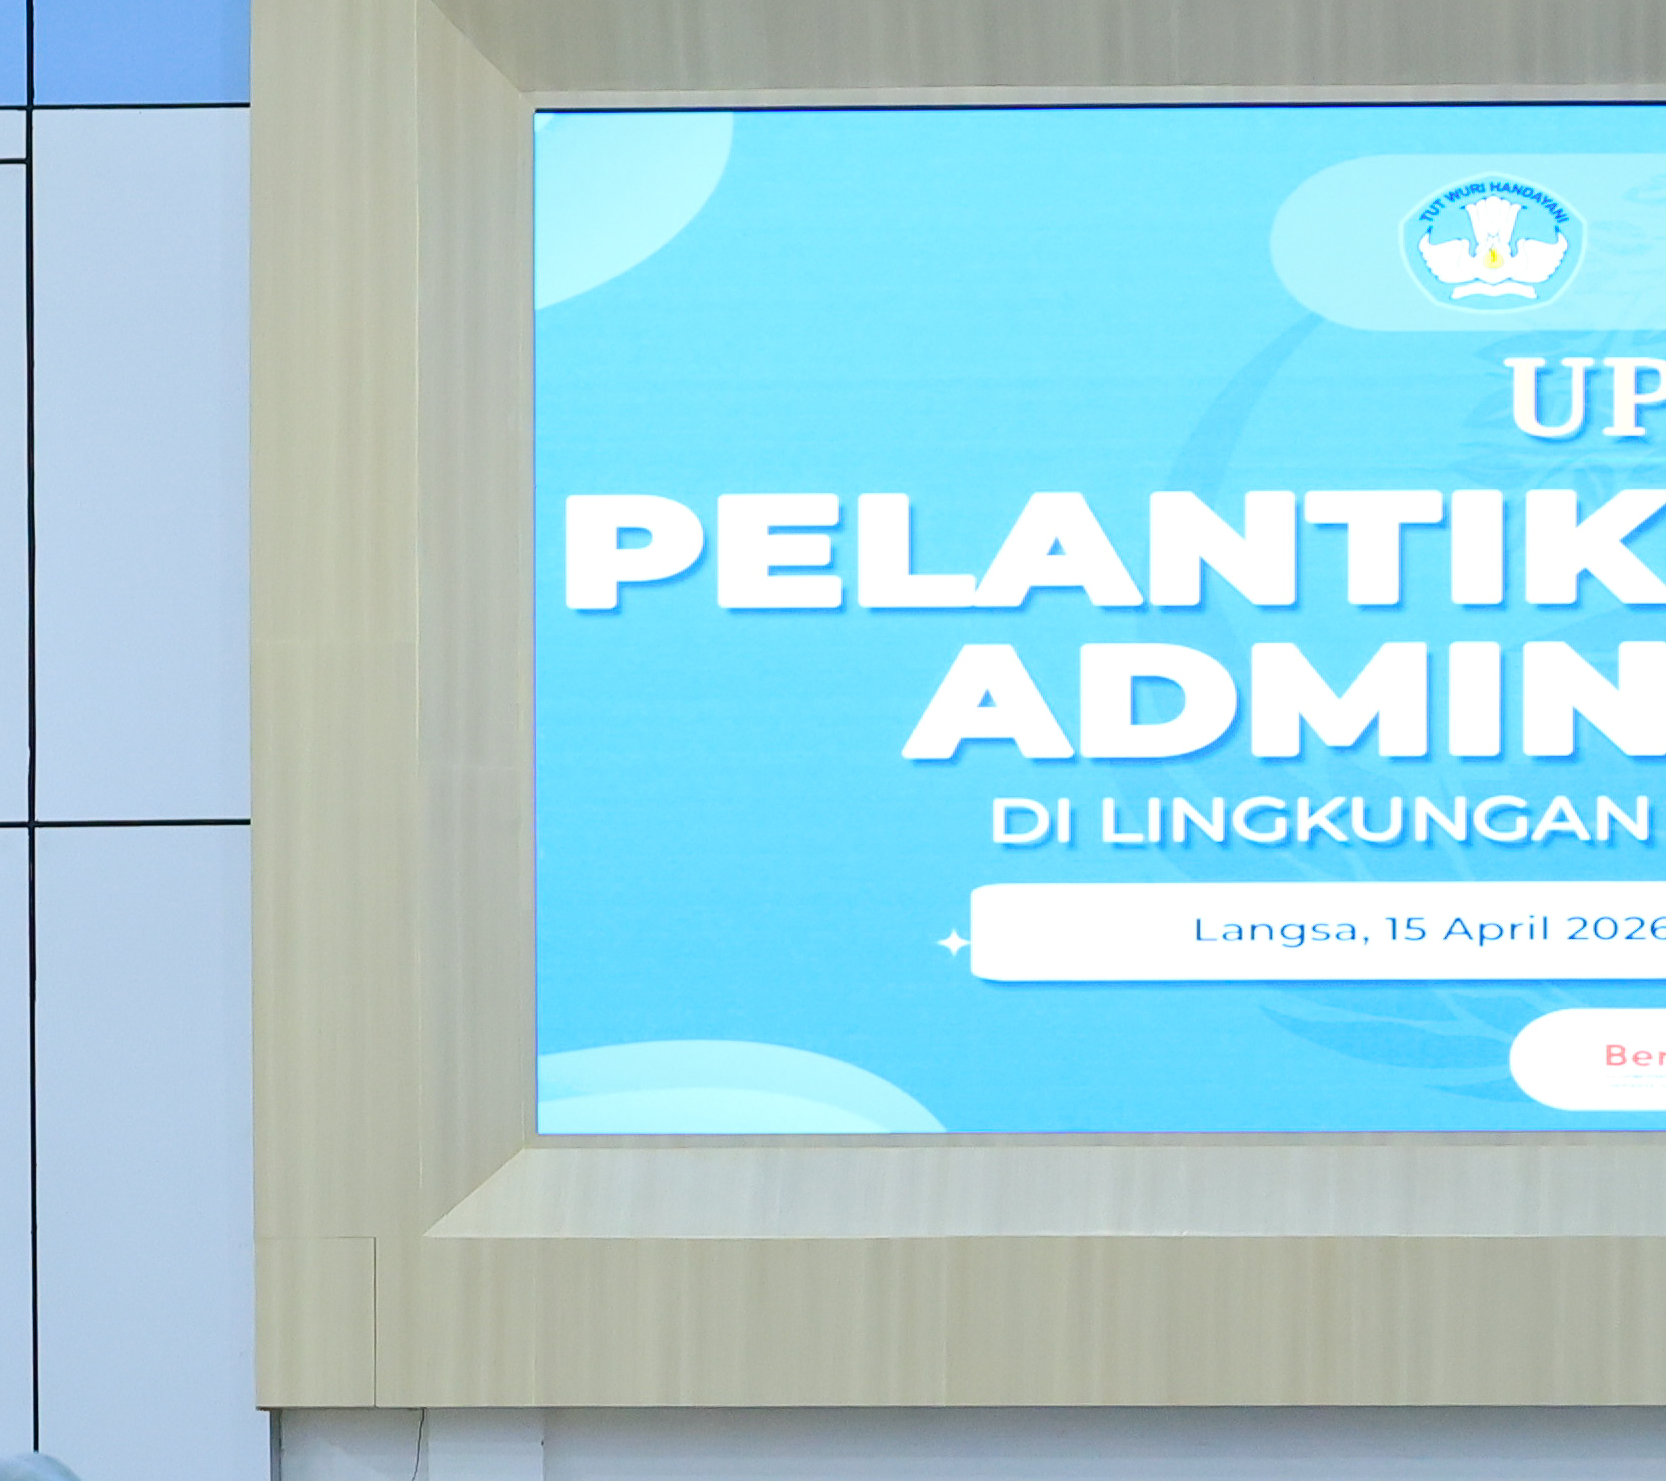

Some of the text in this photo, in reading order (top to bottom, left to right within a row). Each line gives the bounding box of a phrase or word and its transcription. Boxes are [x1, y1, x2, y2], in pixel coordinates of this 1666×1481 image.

[1419, 182, 1570, 223] TUT WURI HANDAYANI
[992, 797, 1071, 844] DI
[1101, 795, 1649, 843] LINGKUNGAN
[1194, 916, 1371, 948] Langsa,
[1385, 916, 1428, 941] 15
[1442, 914, 1549, 948] April
